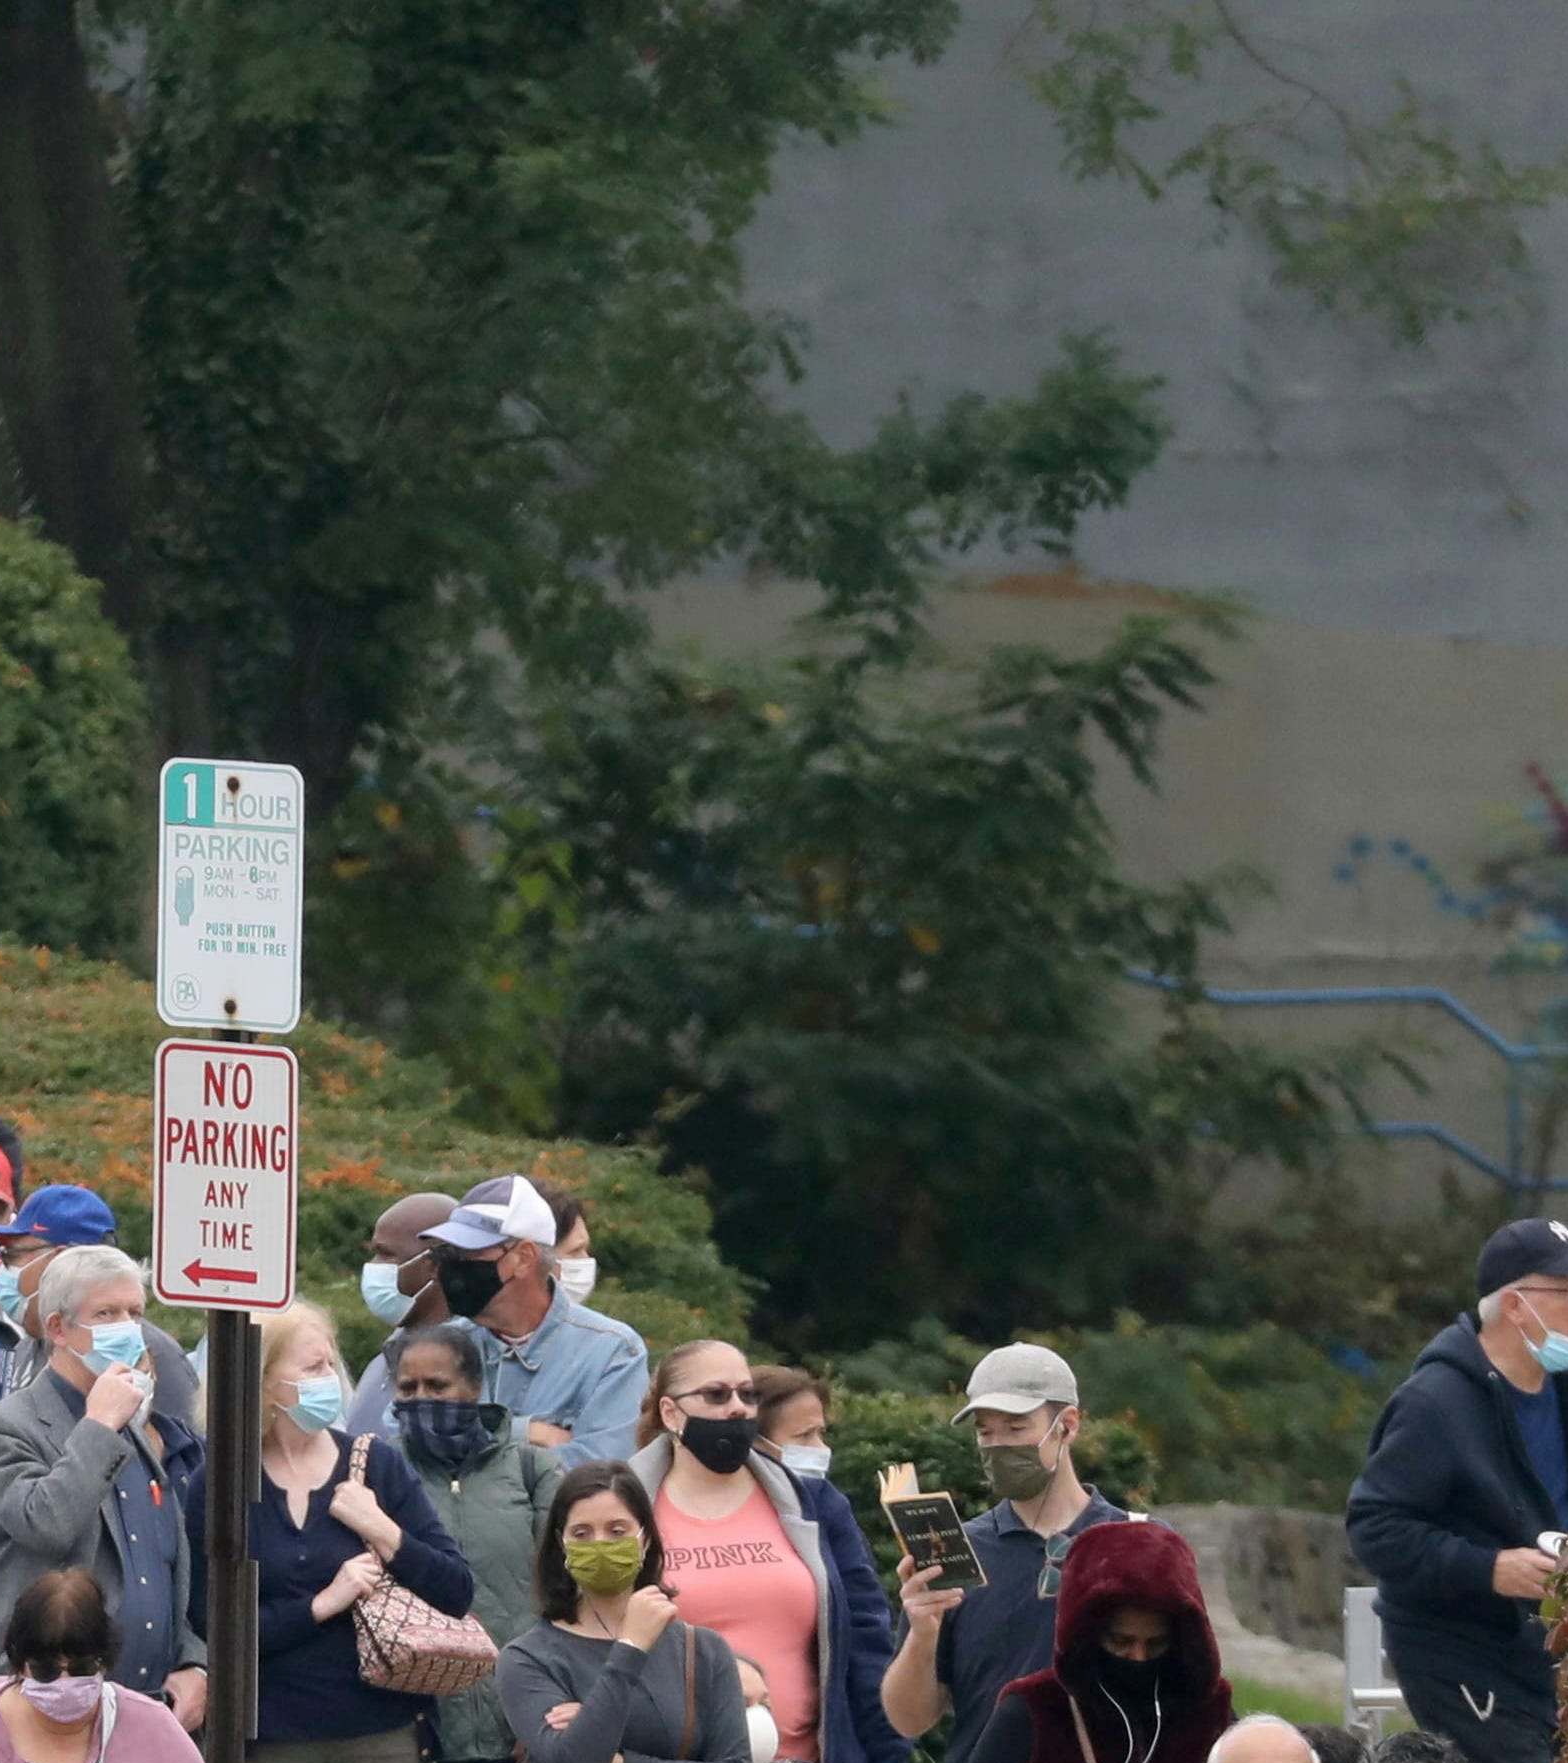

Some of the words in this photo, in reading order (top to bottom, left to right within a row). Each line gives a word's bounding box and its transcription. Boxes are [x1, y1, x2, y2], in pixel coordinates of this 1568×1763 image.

[182, 772, 198, 820] 1
[220, 792, 292, 822] HOUR
[174, 832, 291, 866] PARKING
[203, 866, 234, 881] 9AM
[205, 922, 234, 937] PUSH
[236, 923, 276, 939] BUTTON
[198, 938, 218, 953] FOR
[221, 940, 233, 953] 10
[236, 941, 259, 955] MIN.
[263, 943, 287, 957] FREE
[203, 1060, 253, 1111] NO
[166, 1116, 287, 1173] PARKING
[204, 1180, 249, 1210] ANY
[199, 1219, 254, 1251] TIME
[665, 1542, 783, 1572] PINK
